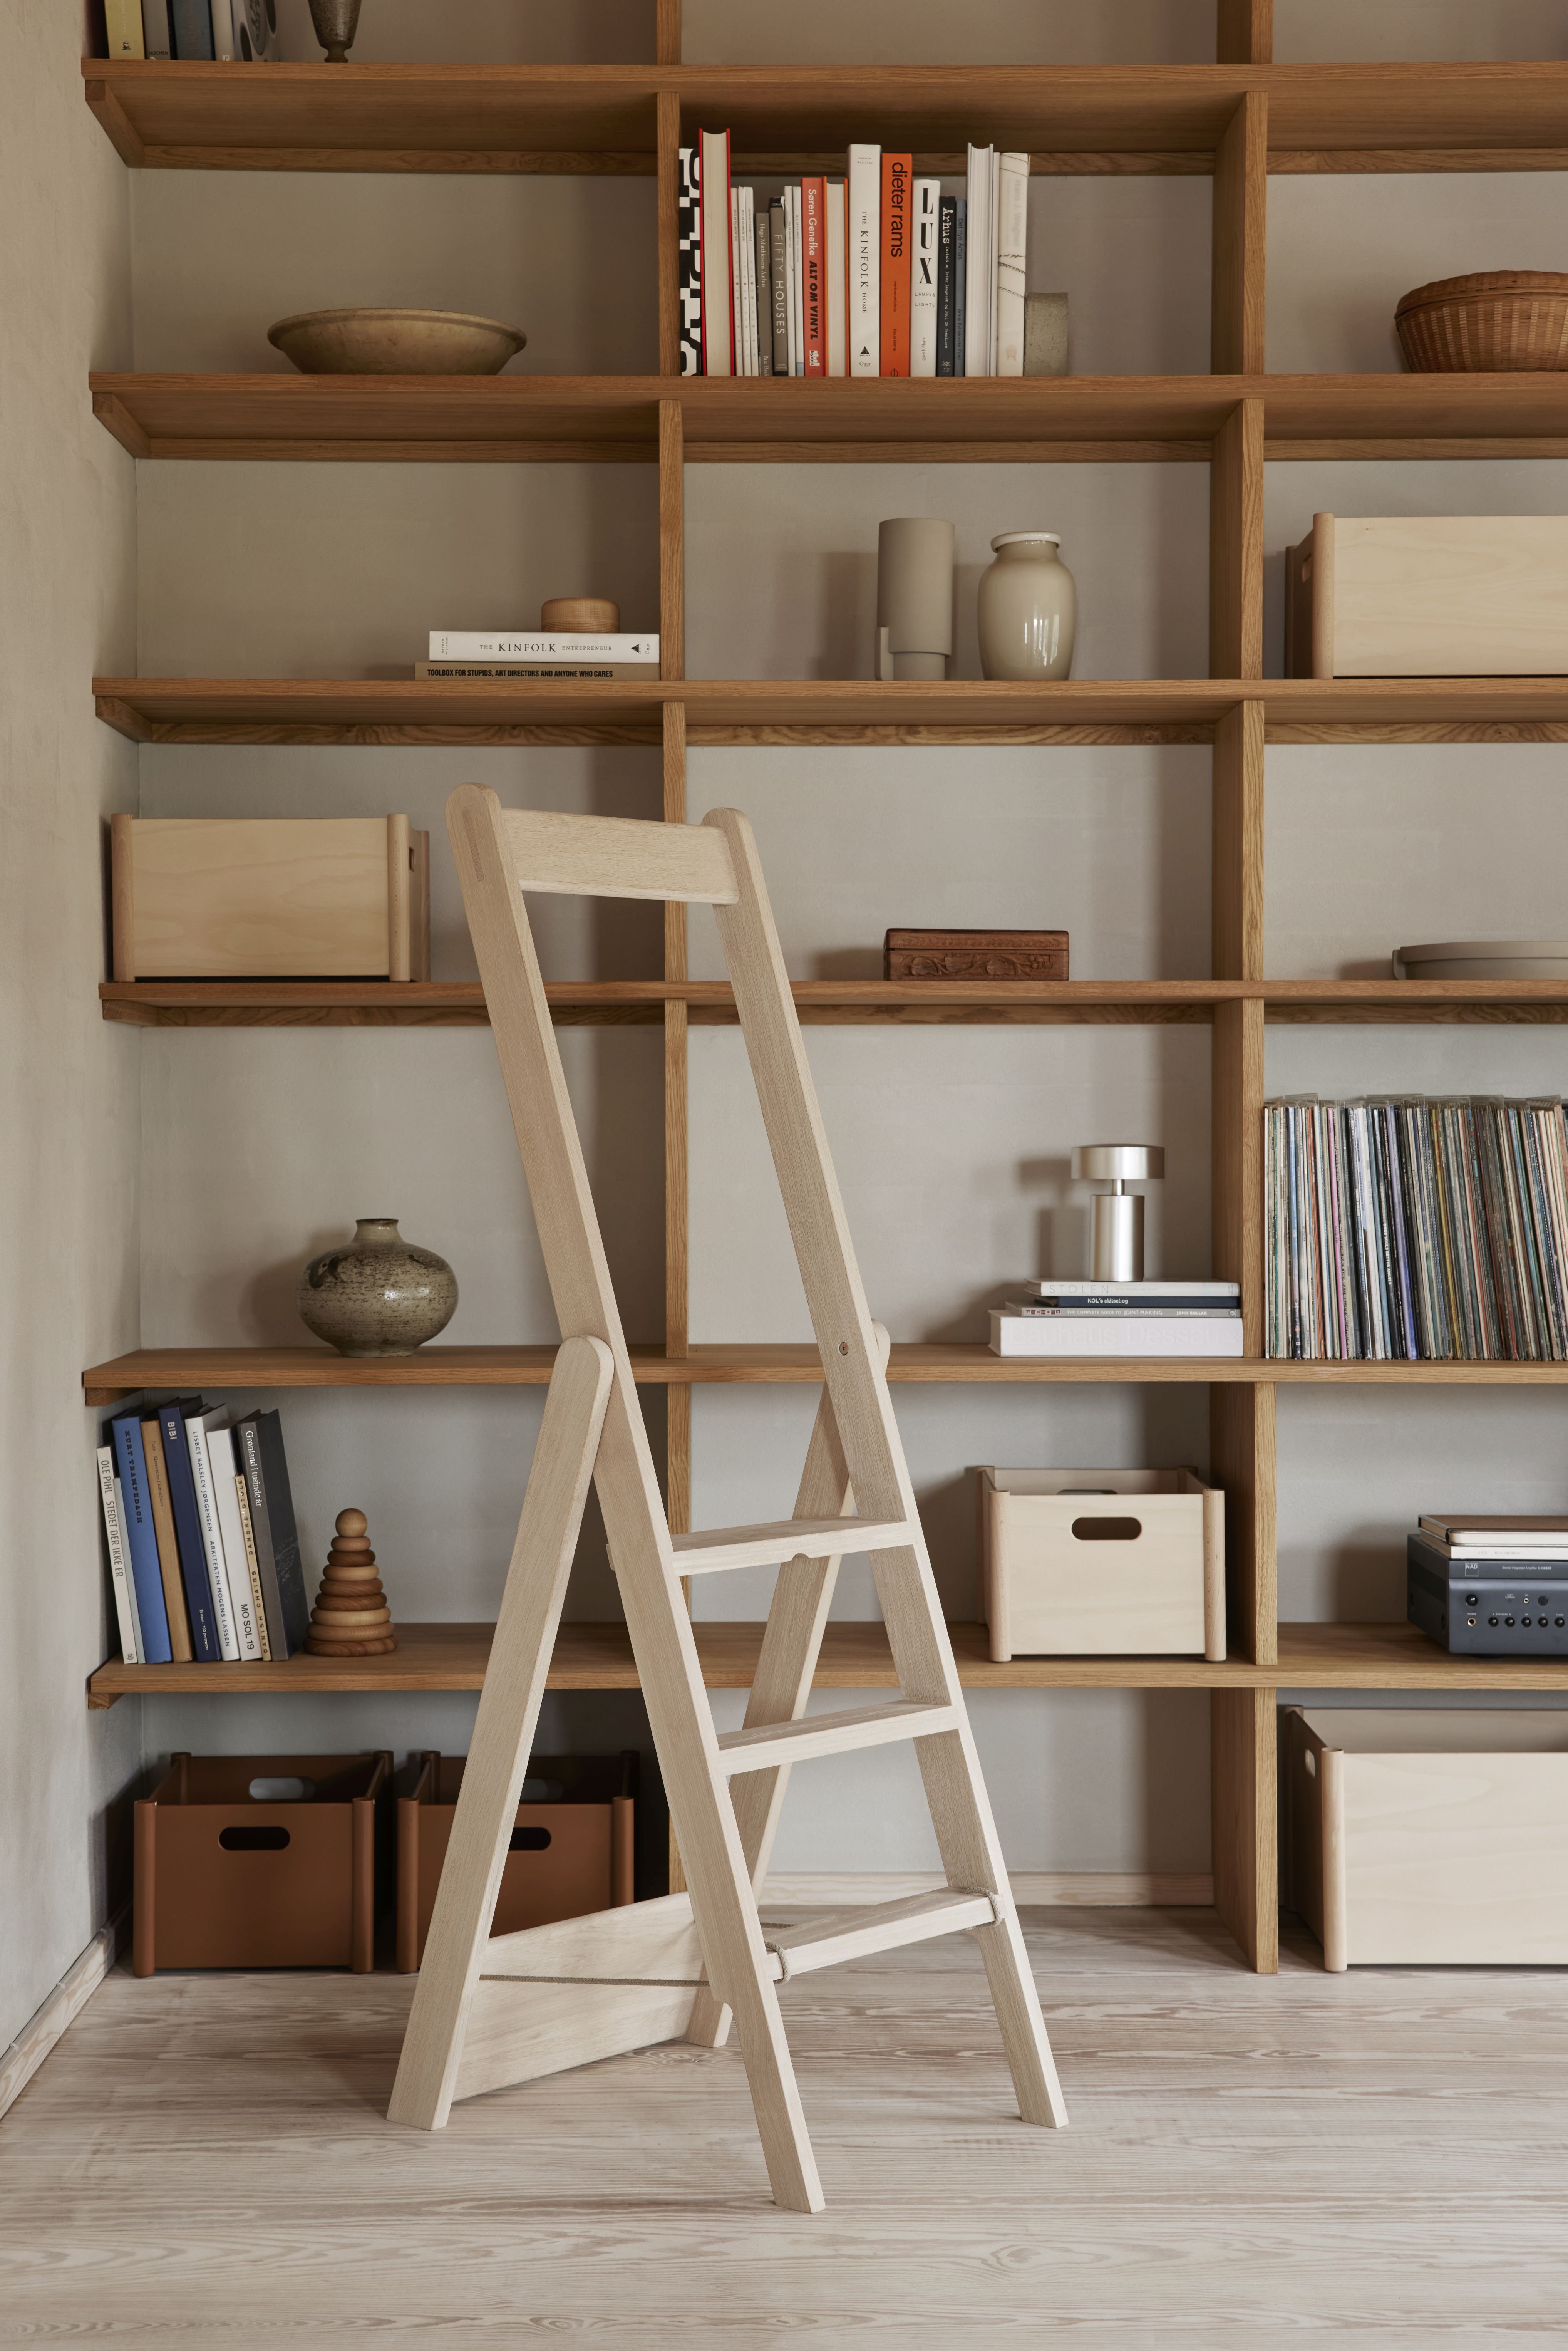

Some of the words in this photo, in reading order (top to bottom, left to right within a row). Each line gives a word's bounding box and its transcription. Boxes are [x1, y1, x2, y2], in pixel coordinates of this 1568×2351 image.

[891, 162, 908, 211] dieter
[808, 189, 817, 215] Søren
[809, 218, 818, 255] Genefke
[891, 215, 903, 257] rams
[918, 187, 934, 284] LUX
[943, 207, 954, 244] Århus
[774, 235, 784, 271] FIFTY
[860, 231, 868, 288] KINFOLK
[809, 260, 818, 280] ALT
[809, 283, 818, 302] OM
[776, 281, 785, 334] HOUSES
[810, 306, 818, 340] VINYL
[499, 643, 556, 652] KINFOLK
[1049, 1285, 1109, 1293] STOLEN
[1010, 1323, 1118, 1345] Bauhaus
[1127, 1323, 1220, 1345] Dessau
[168, 1421, 177, 1440] BIBI
[193, 1431, 201, 1455] LISBET
[101, 1460, 110, 1474] OLE
[125, 1430, 133, 1456] KURT
[129, 1459, 142, 1523] TRAMPEDACH
[197, 1458, 206, 1488] BALSLEV
[103, 1476, 112, 1494] PIHL
[251, 1472, 262, 1497] tusinde
[106, 1501, 117, 1528] STEDET
[201, 1491, 212, 1531] JØRGENSEN
[110, 1530, 119, 1545] DER
[244, 1517, 253, 1555] DANSKE
[112, 1548, 122, 1565] IKKE
[210, 1541, 221, 1585] ARKITEKTEN
[115, 1567, 123, 1577] ER
[217, 1588, 226, 1617] MOGENS
[252, 1571, 261, 1607] CHAIRS
[241, 1604, 250, 1618] MO
[222, 1620, 230, 1647] LASSEN
[243, 1620, 252, 1638] SOL
[258, 1616, 268, 1653] DANISH
[246, 1640, 255, 1650] 19
